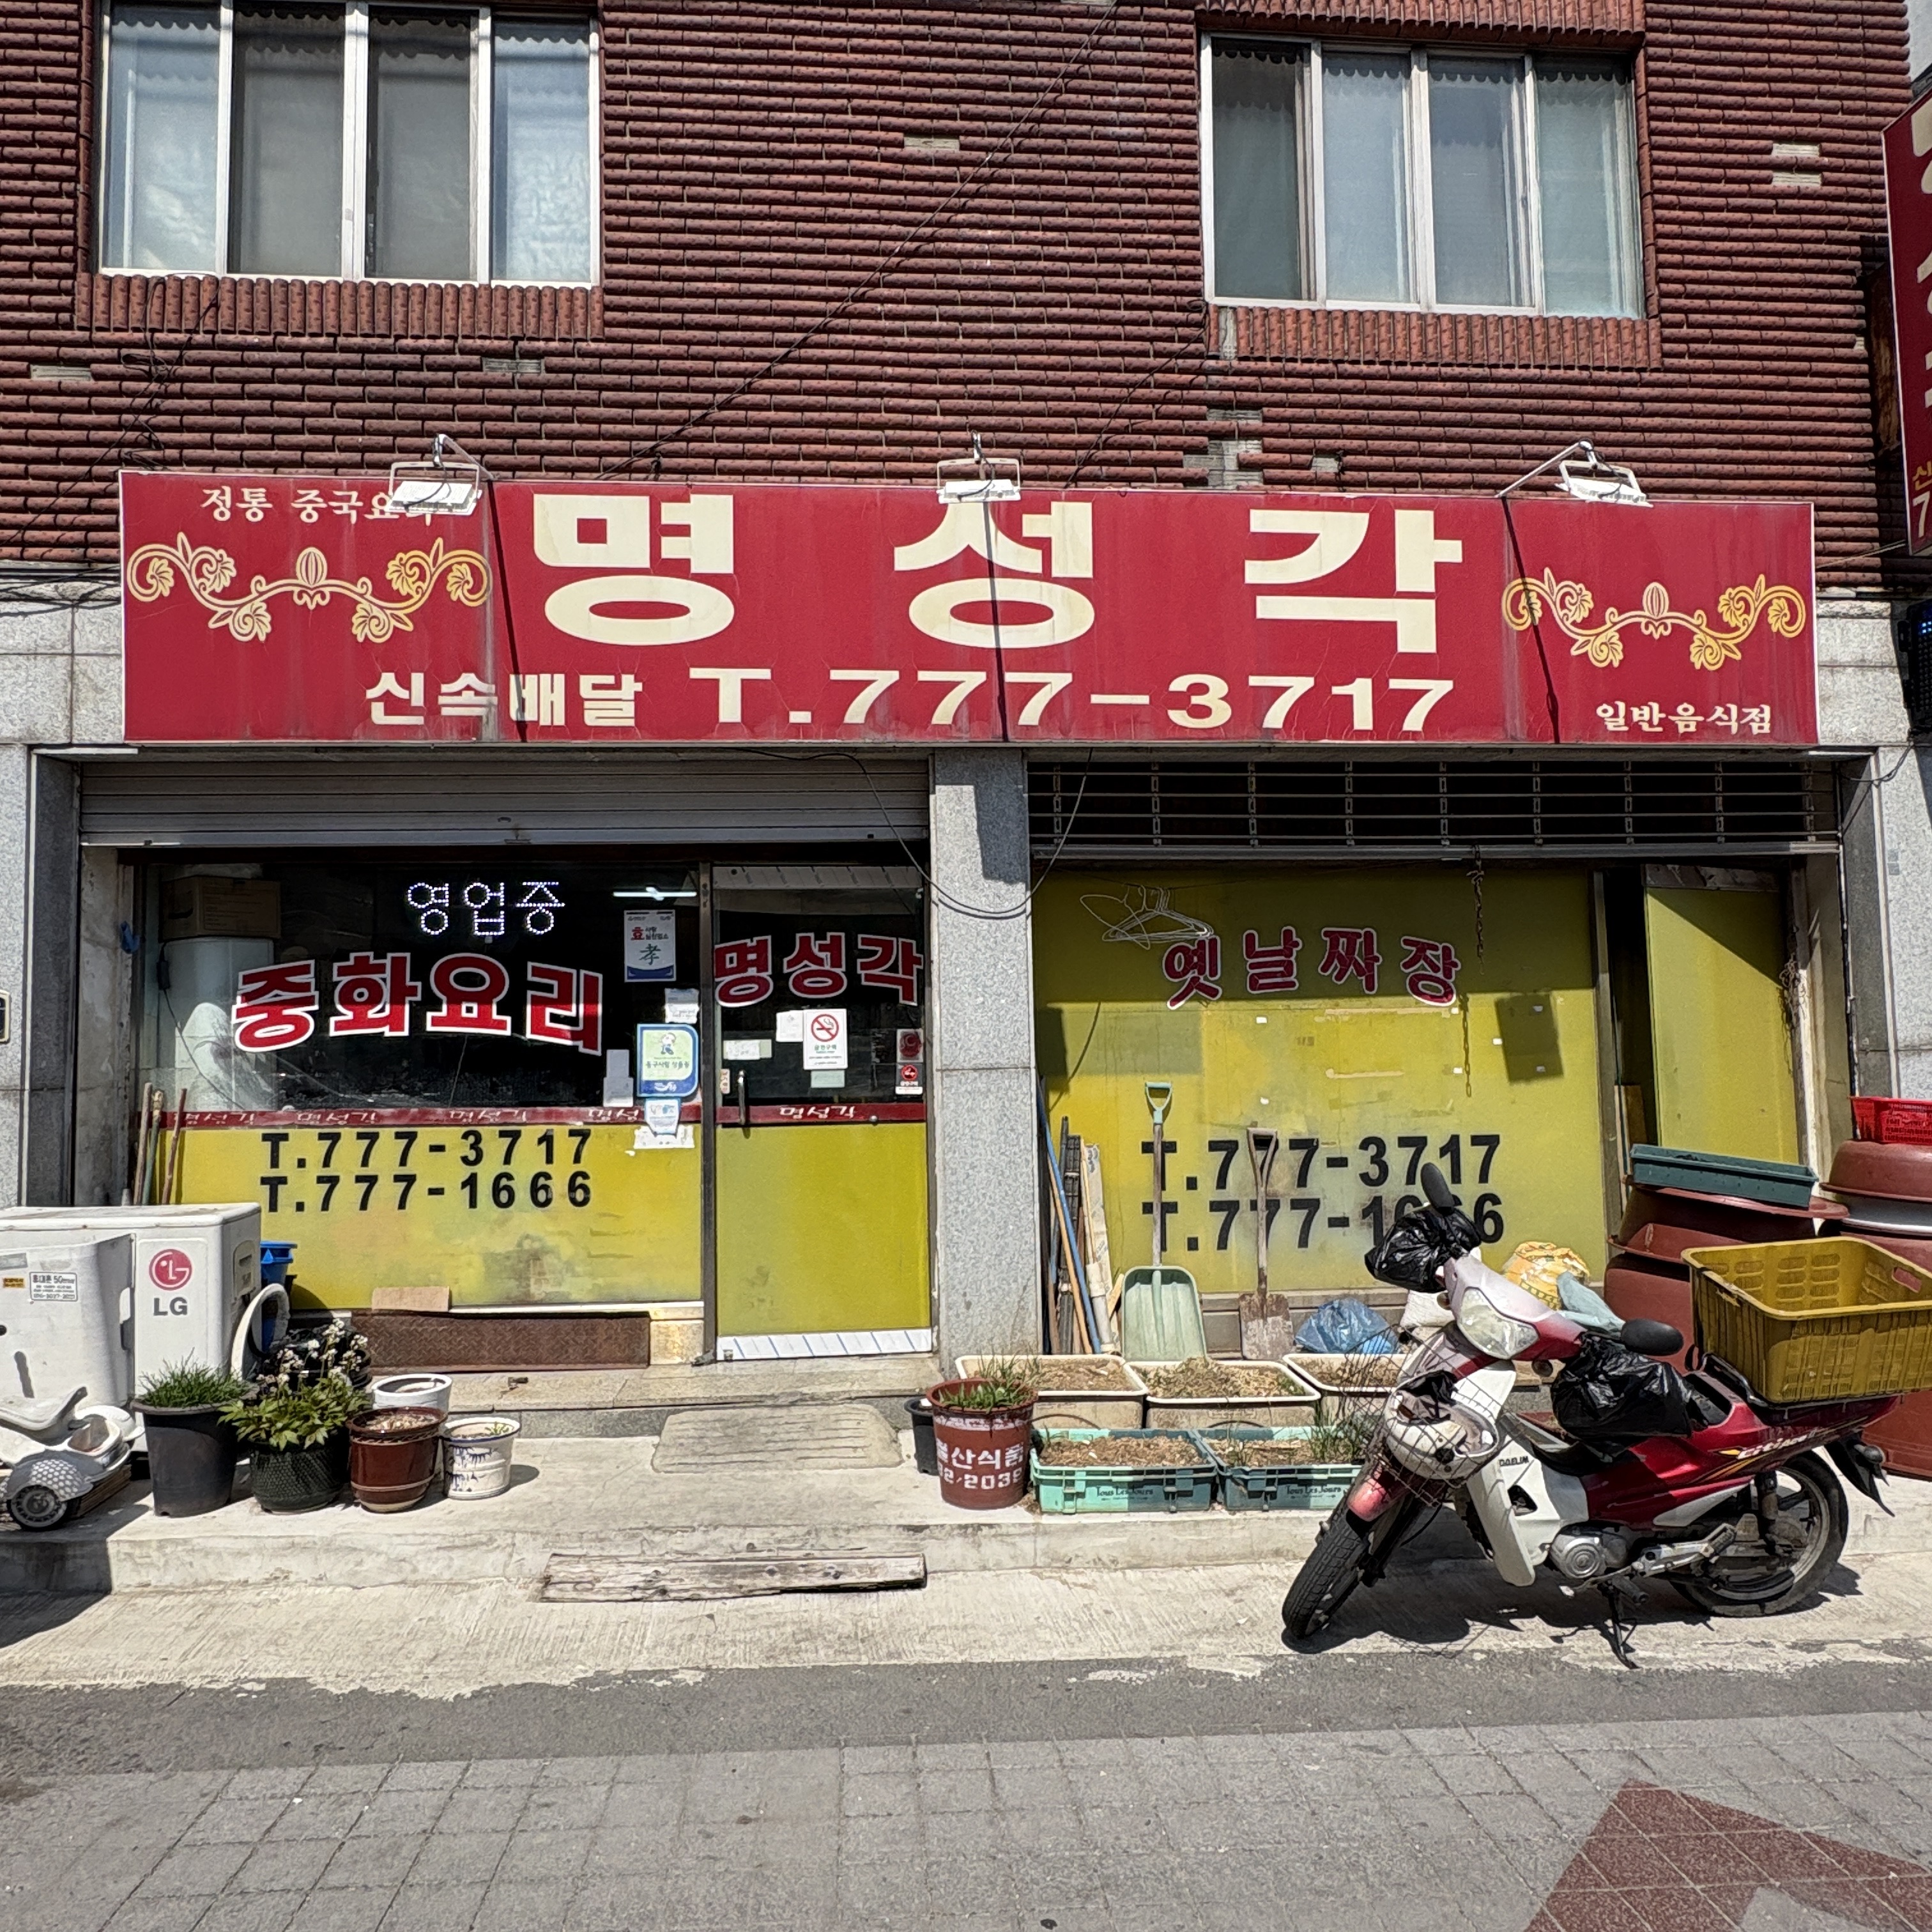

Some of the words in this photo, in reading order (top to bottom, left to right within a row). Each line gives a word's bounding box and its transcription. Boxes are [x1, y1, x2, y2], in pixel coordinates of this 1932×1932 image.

[201, 486, 273, 523] 정통
[290, 487, 433, 526] 중국요
[533, 493, 1463, 654] 명성각
[365, 672, 643, 727] 신속배달
[1596, 701, 1772, 736] 일반음식점
[408, 881, 565, 935] 영업중
[714, 932, 923, 1007] 명성각
[231, 952, 603, 1056] 중화요리
[779, 1105, 856, 1119] 명성각
[261, 1128, 592, 1169] T.777-3717
[259, 1171, 592, 1213] T.777-1666
[1141, 1192, 1504, 1252] T.777-16
[153, 1297, 188, 1316] LG
